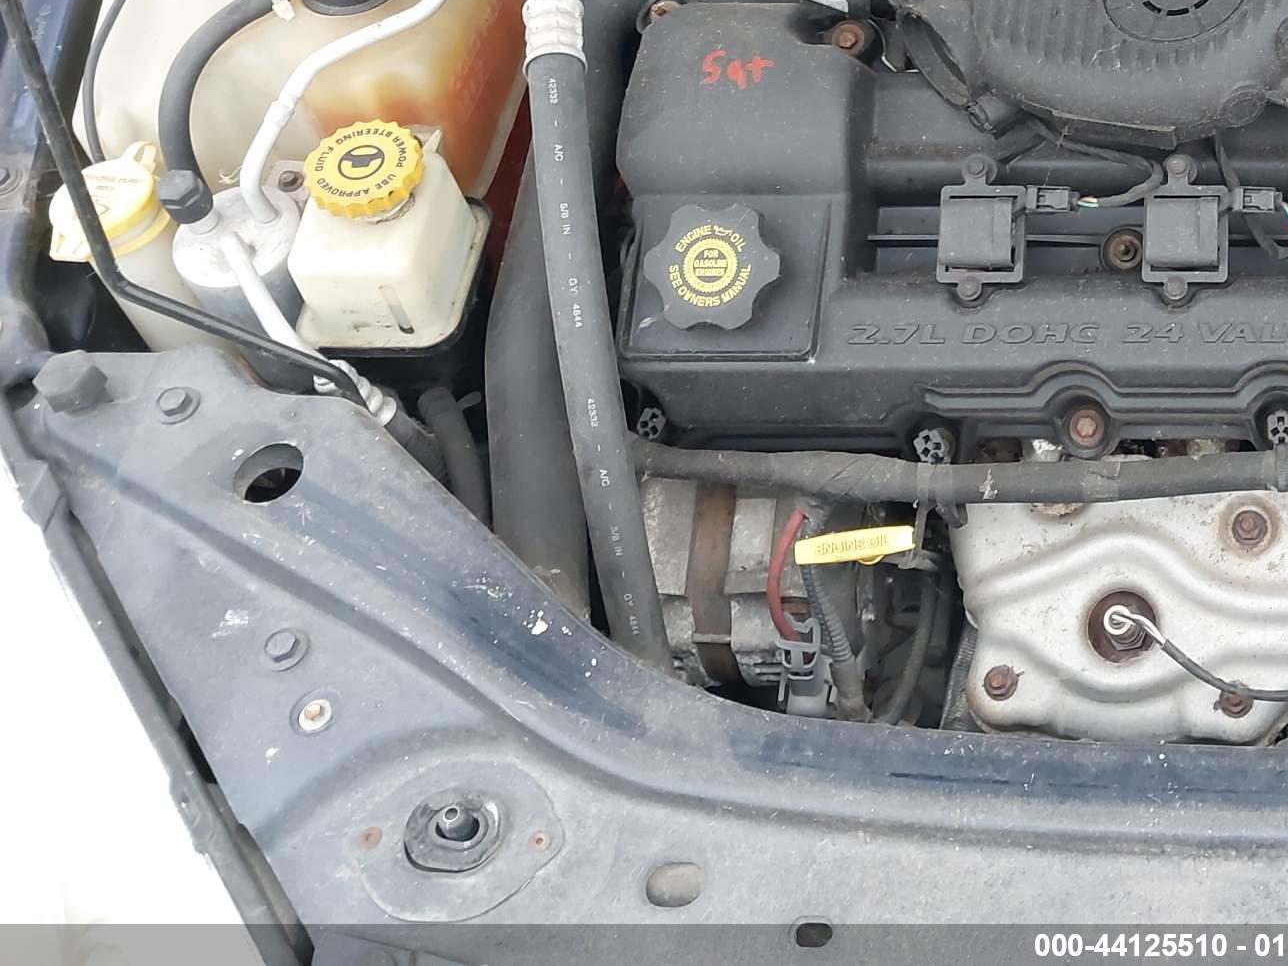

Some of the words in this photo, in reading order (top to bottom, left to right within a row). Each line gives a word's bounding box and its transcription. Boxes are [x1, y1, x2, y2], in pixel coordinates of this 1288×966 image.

[336, 128, 394, 145] STEERING
[315, 146, 335, 172] FLUID
[393, 136, 407, 167] POWER
[317, 177, 370, 197] APPROVED
[554, 144, 564, 162] A/C
[563, 224, 571, 235] IN
[675, 224, 712, 252] ENGINE
[730, 233, 748, 252] OIL
[703, 250, 719, 259] FOR
[669, 264, 683, 289] SEE
[678, 286, 721, 307] OWNERS
[721, 264, 751, 303] MANUAL
[847, 322, 946, 346] 2.7L
[960, 322, 1101, 346] DOHC
[1122, 321, 1185, 344] 24
[817, 539, 865, 556] ENGINE
[869, 534, 888, 547] OIL
